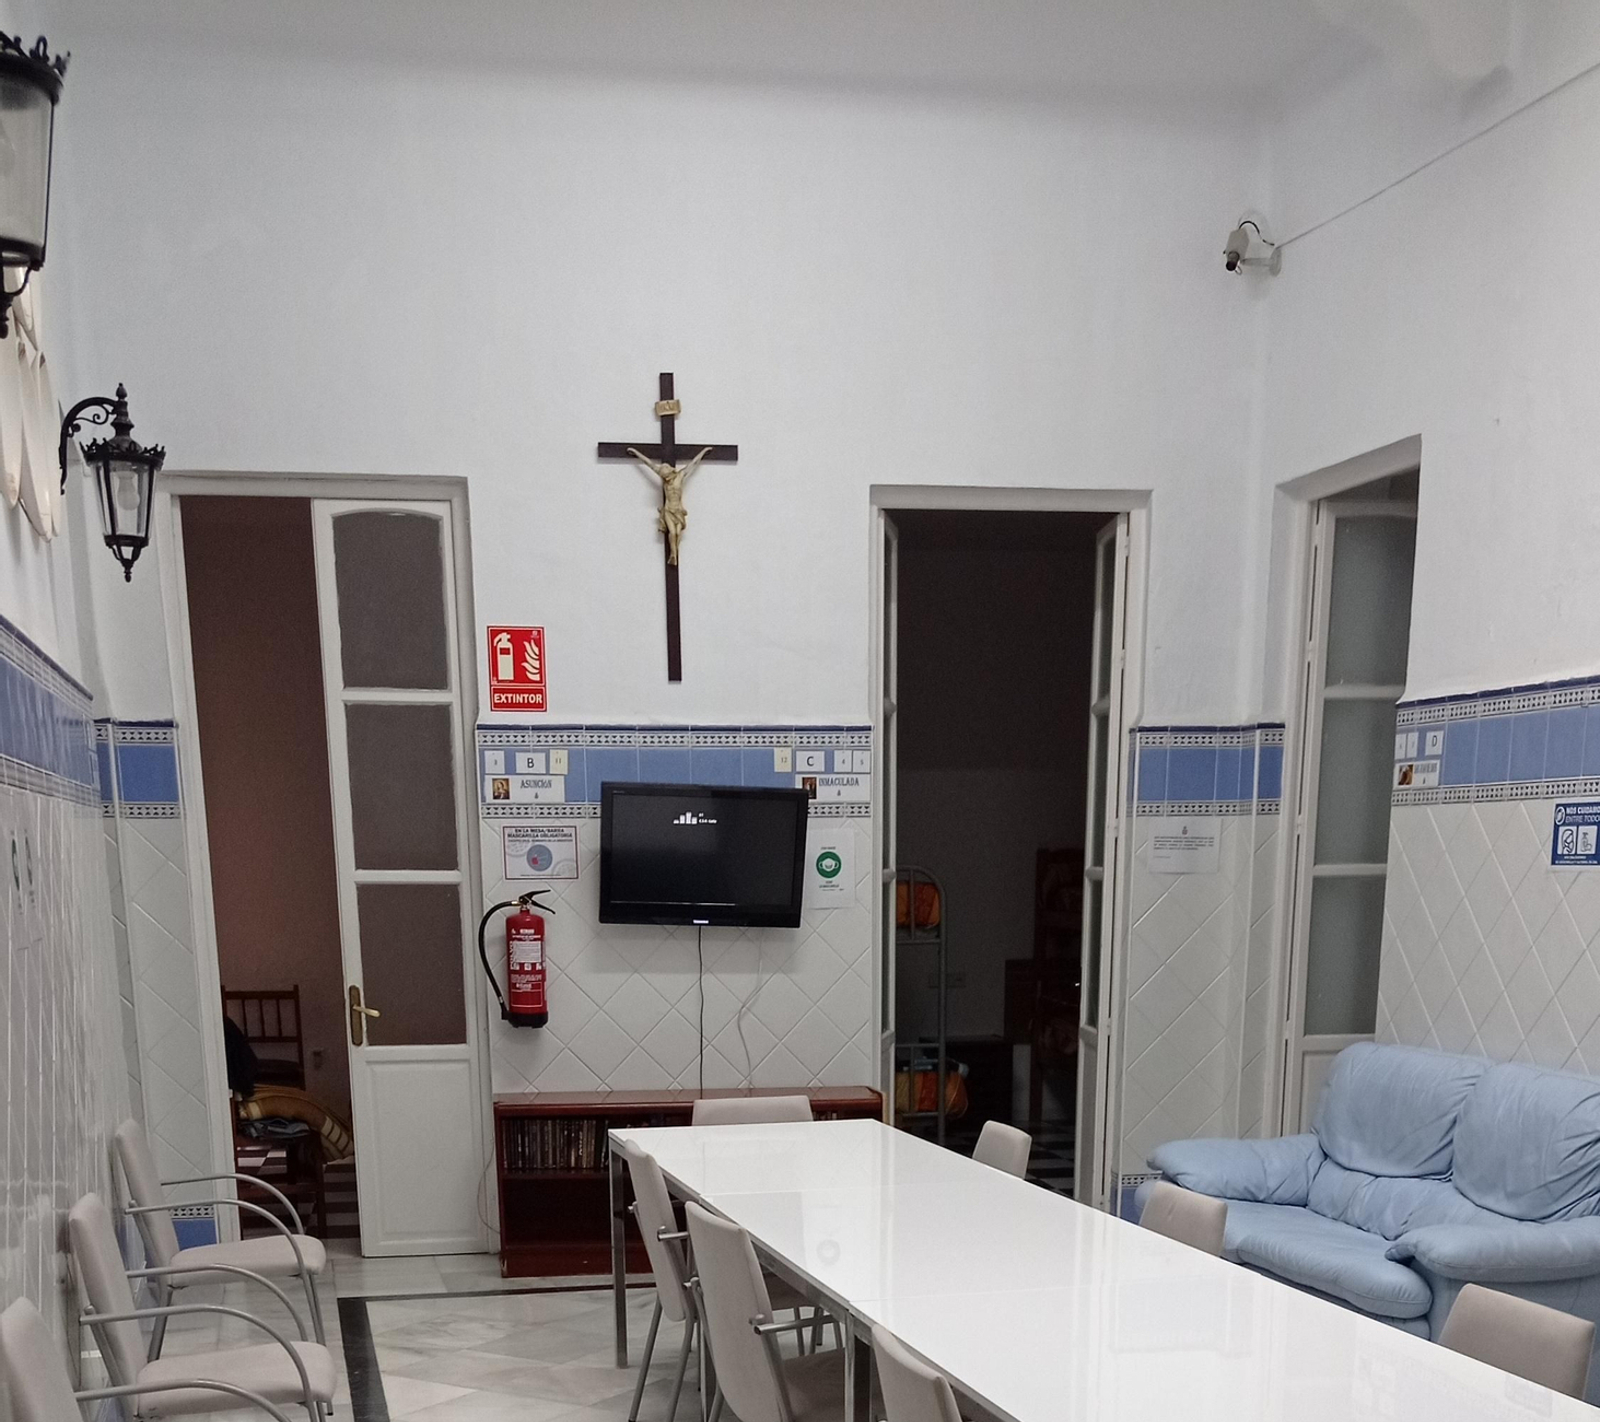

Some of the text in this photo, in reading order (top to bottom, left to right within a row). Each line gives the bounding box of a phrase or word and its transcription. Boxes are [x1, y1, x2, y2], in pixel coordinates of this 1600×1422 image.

[494, 693, 543, 704] EXTINTOR
[1432, 735, 1438, 747] D
[527, 758, 534, 768] B
[806, 756, 814, 766] C
